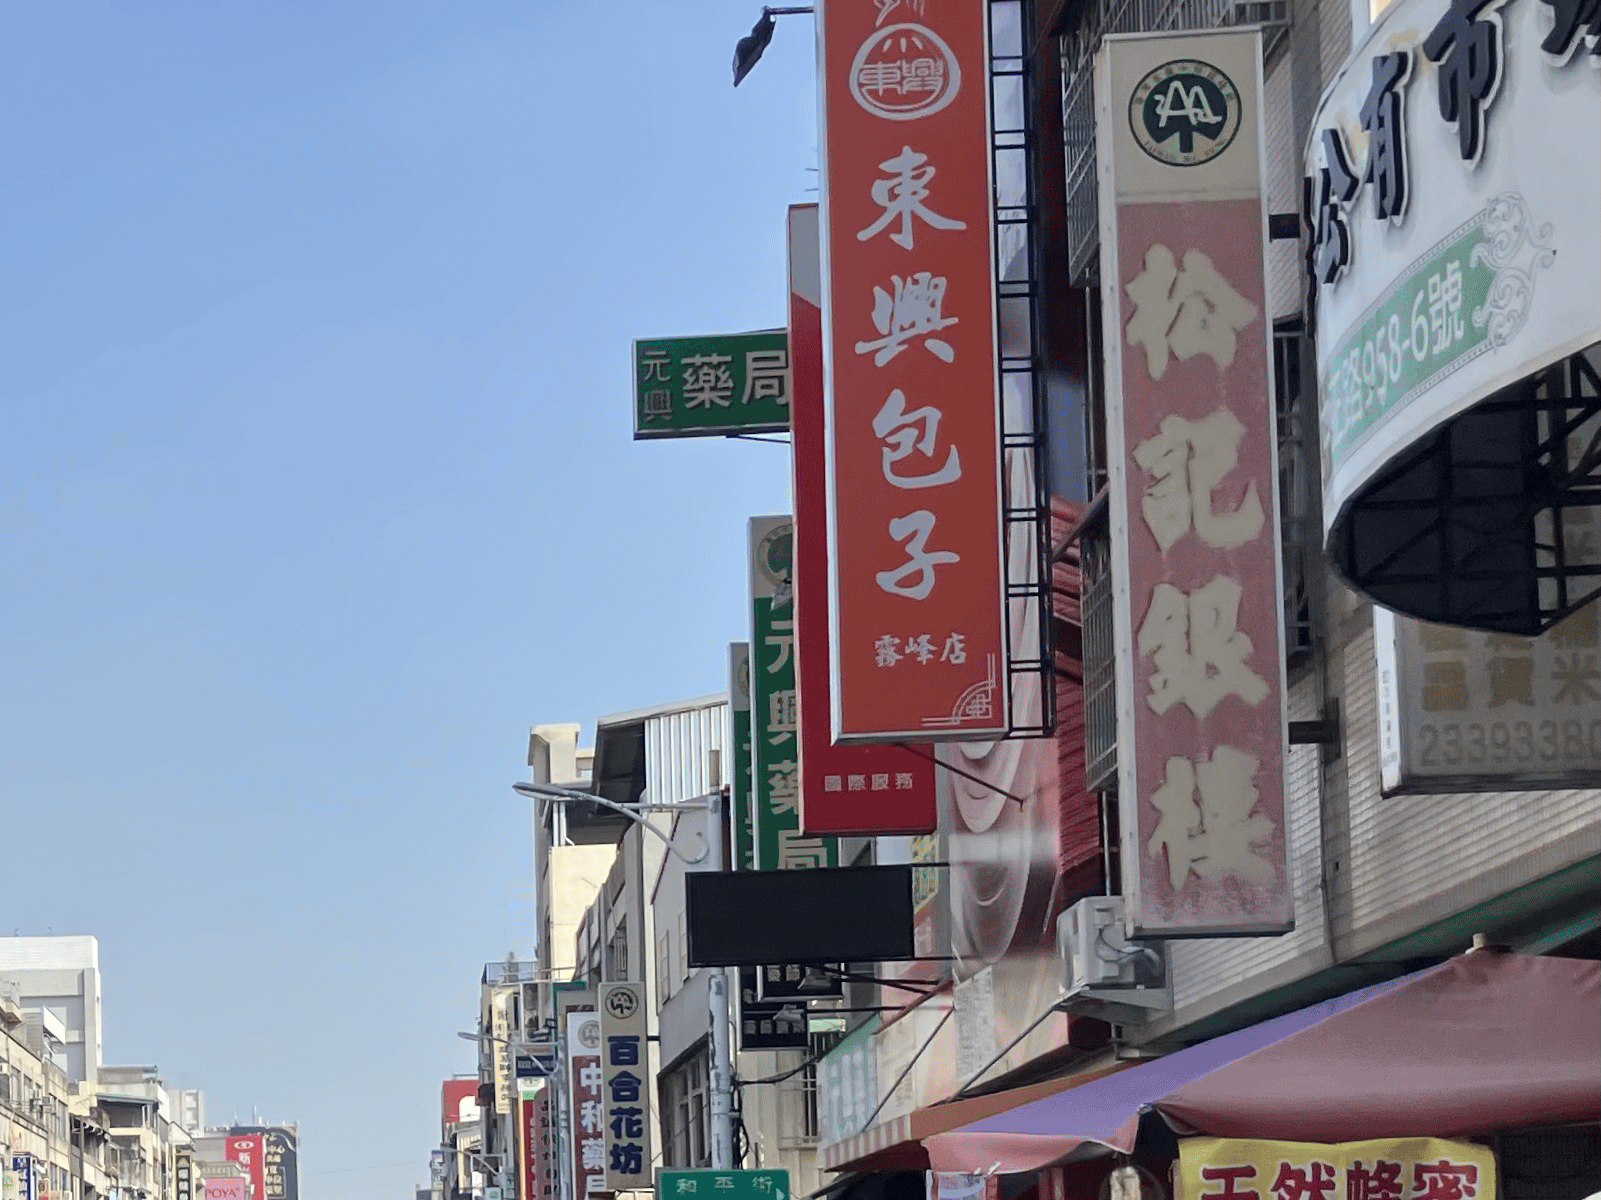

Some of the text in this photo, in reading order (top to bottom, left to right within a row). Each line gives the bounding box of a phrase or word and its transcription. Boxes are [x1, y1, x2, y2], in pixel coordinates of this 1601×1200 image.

[681, 350, 790, 408] 藥局
[855, 144, 967, 602] 東興包子
[1125, 244, 1277, 892] 松記銀樓
[874, 633, 966, 668] 霧峰店
[608, 1035, 644, 1175] 百合花坊
[676, 1175, 773, 1195] 和平街
